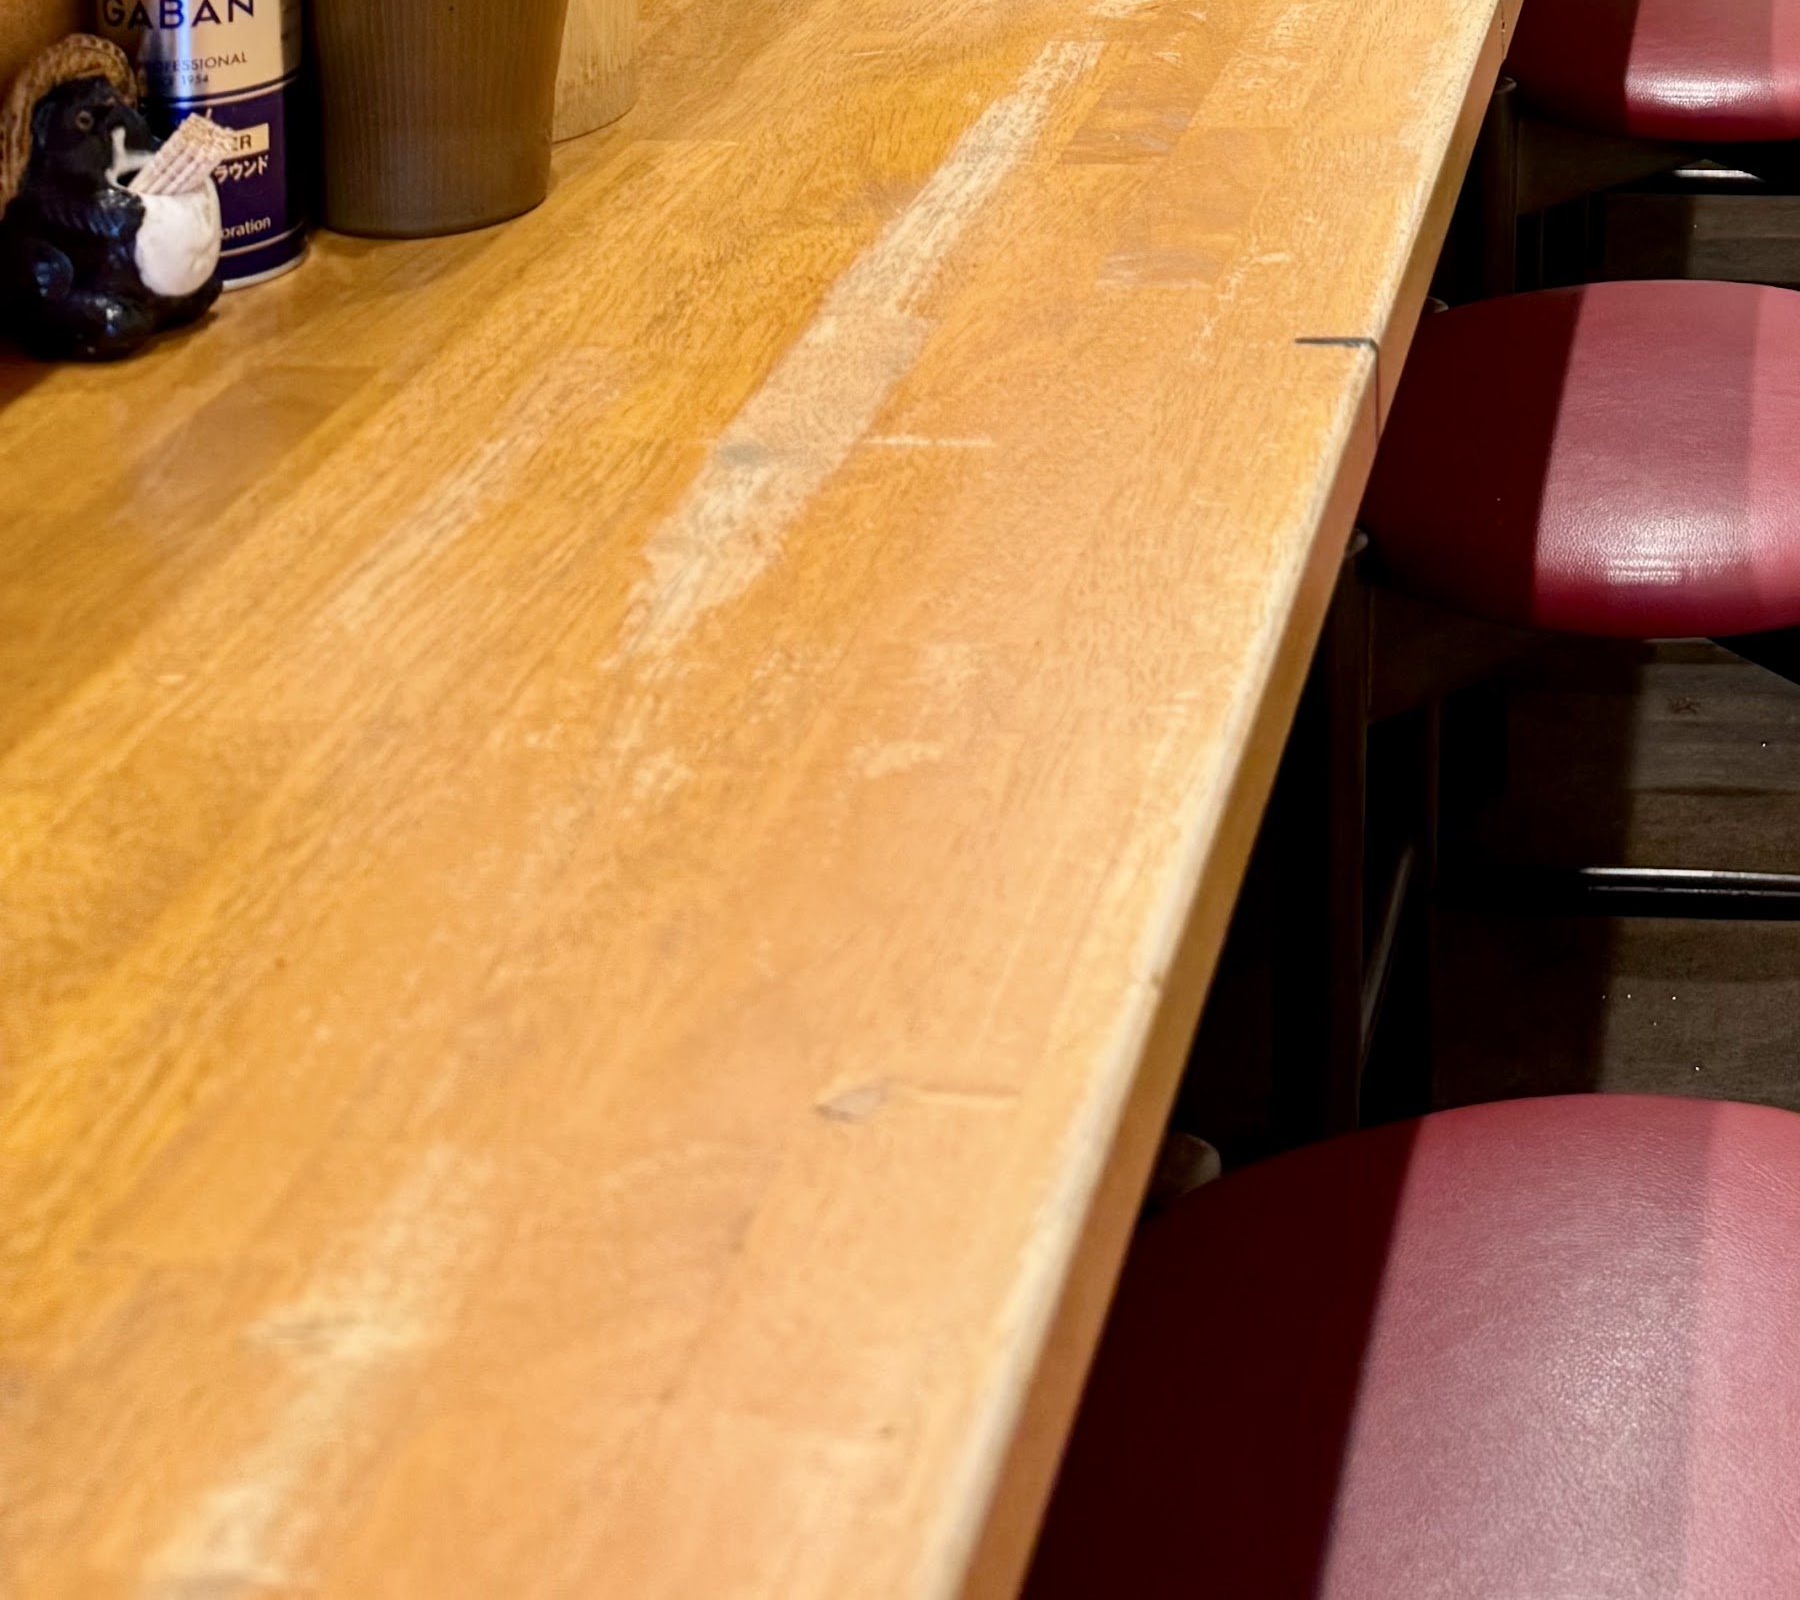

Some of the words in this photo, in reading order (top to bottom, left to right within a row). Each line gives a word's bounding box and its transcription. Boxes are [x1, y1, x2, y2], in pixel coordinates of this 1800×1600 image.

[213, 154, 268, 185] ラウンド
[222, 215, 272, 240] oration
